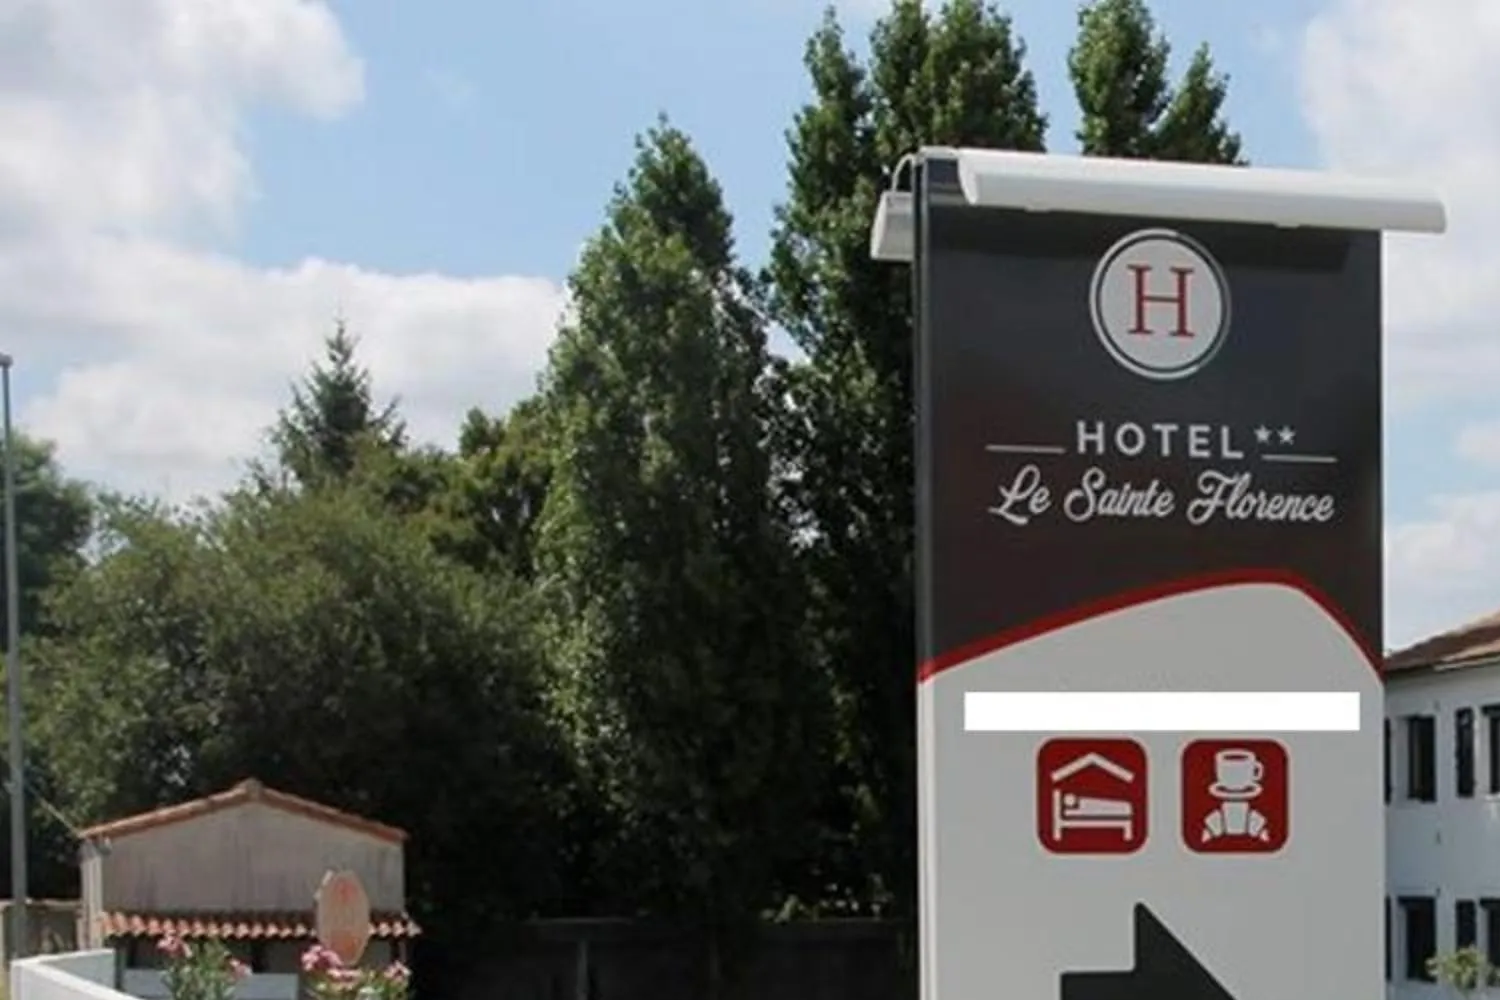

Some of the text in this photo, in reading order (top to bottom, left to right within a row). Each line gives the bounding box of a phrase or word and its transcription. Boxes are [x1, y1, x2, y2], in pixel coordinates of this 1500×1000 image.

[1127, 263, 1195, 338] H
[1076, 420, 1245, 459] HOTEL
[988, 464, 1336, 525] Le Sainte Florence
